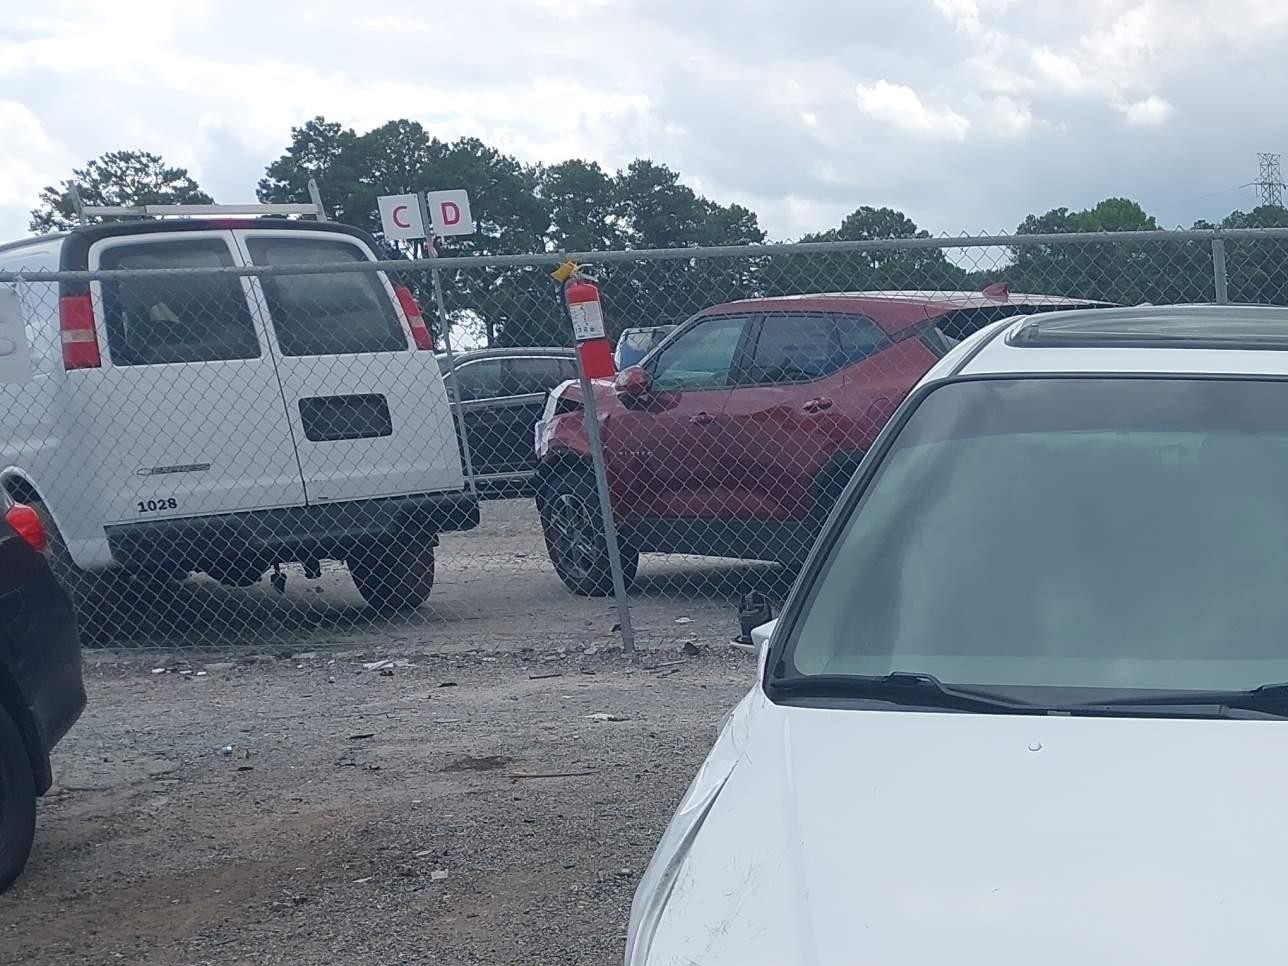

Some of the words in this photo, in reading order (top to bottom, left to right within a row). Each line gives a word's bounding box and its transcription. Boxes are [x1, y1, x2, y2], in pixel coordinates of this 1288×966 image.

[392, 205, 411, 228] C
[440, 201, 460, 225] D
[137, 498, 178, 513] 1028
